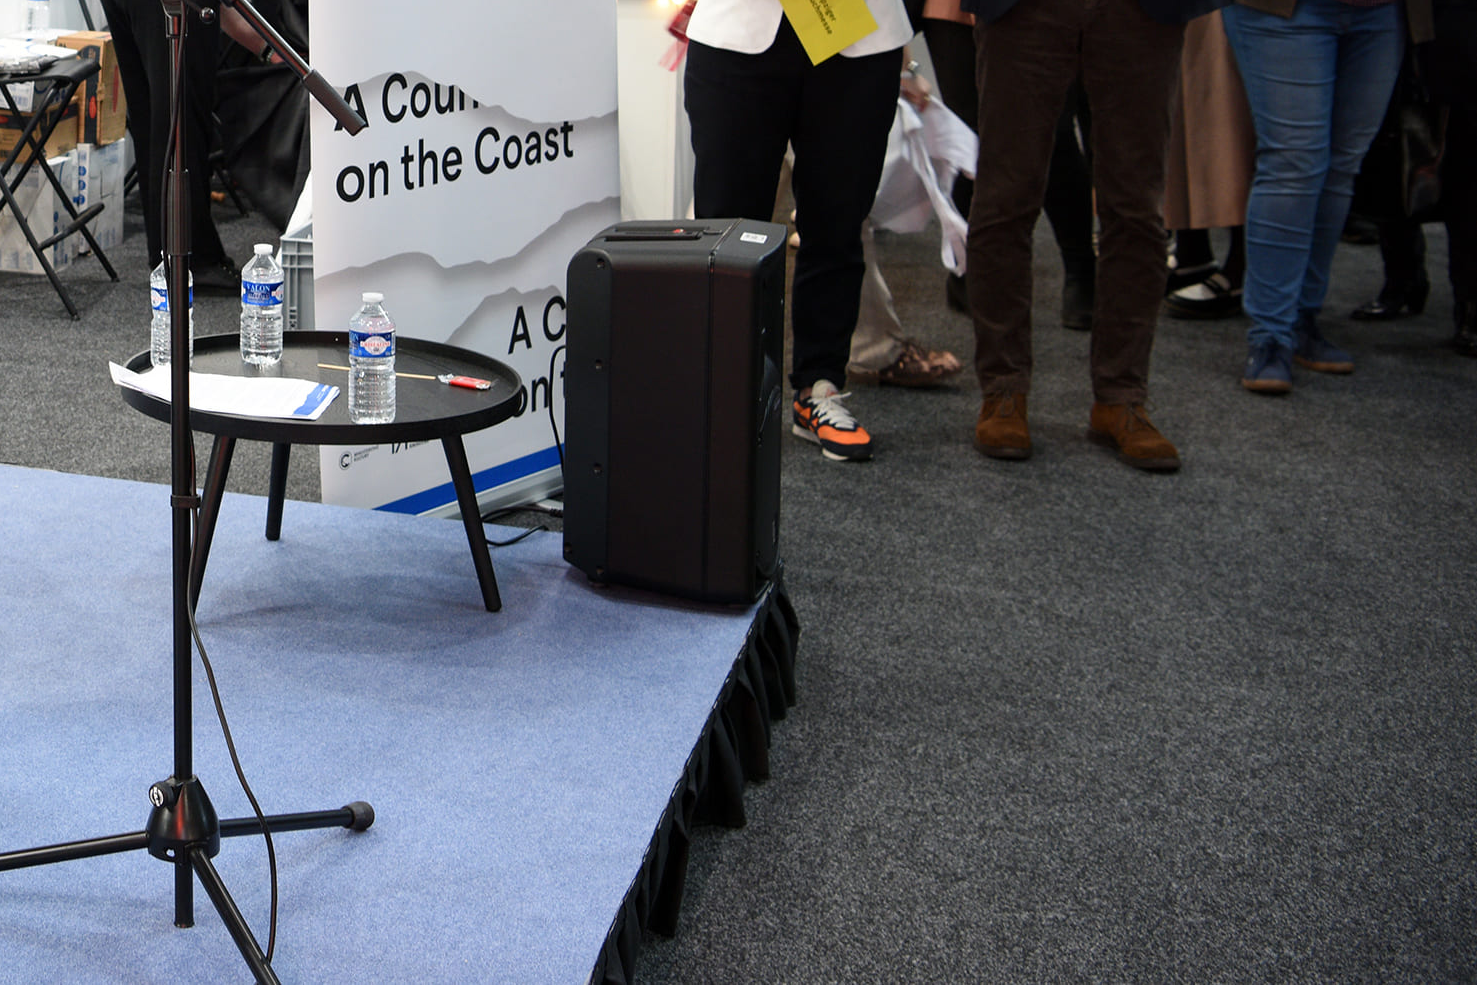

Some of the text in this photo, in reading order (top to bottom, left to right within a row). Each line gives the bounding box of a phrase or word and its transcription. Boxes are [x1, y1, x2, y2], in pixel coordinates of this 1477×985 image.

[335, 121, 575, 202] on the Coast
[508, 305, 532, 355] A
